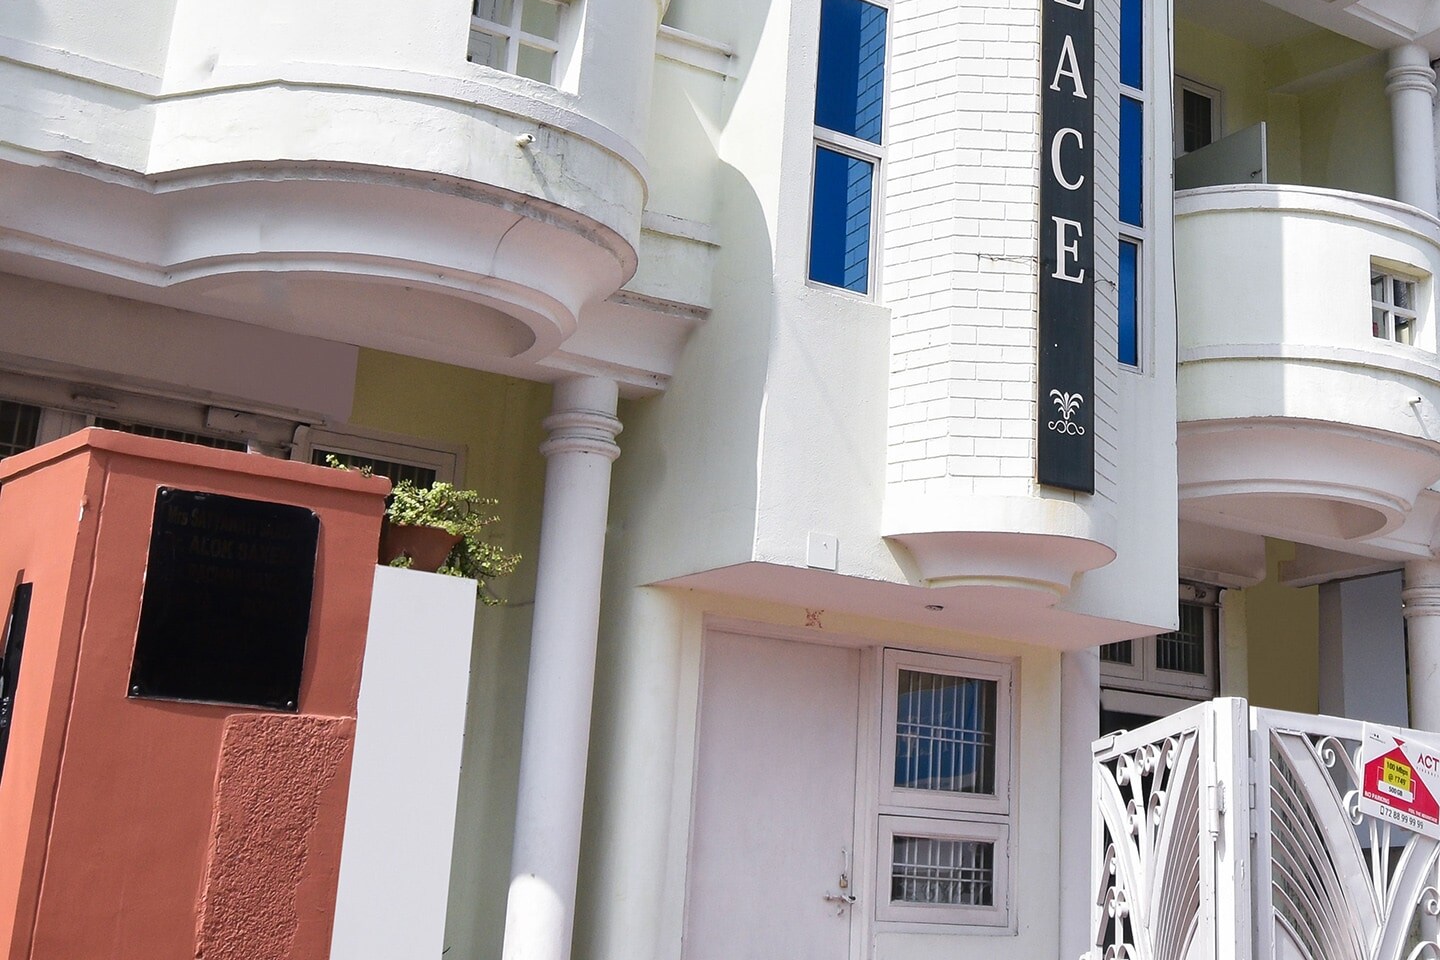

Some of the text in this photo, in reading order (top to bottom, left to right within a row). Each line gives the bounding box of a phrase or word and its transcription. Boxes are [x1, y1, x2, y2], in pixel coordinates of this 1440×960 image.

[1386, 762, 1396, 771] 100
[1418, 754, 1439, 772] ACT
[1385, 808, 1392, 818] 72
